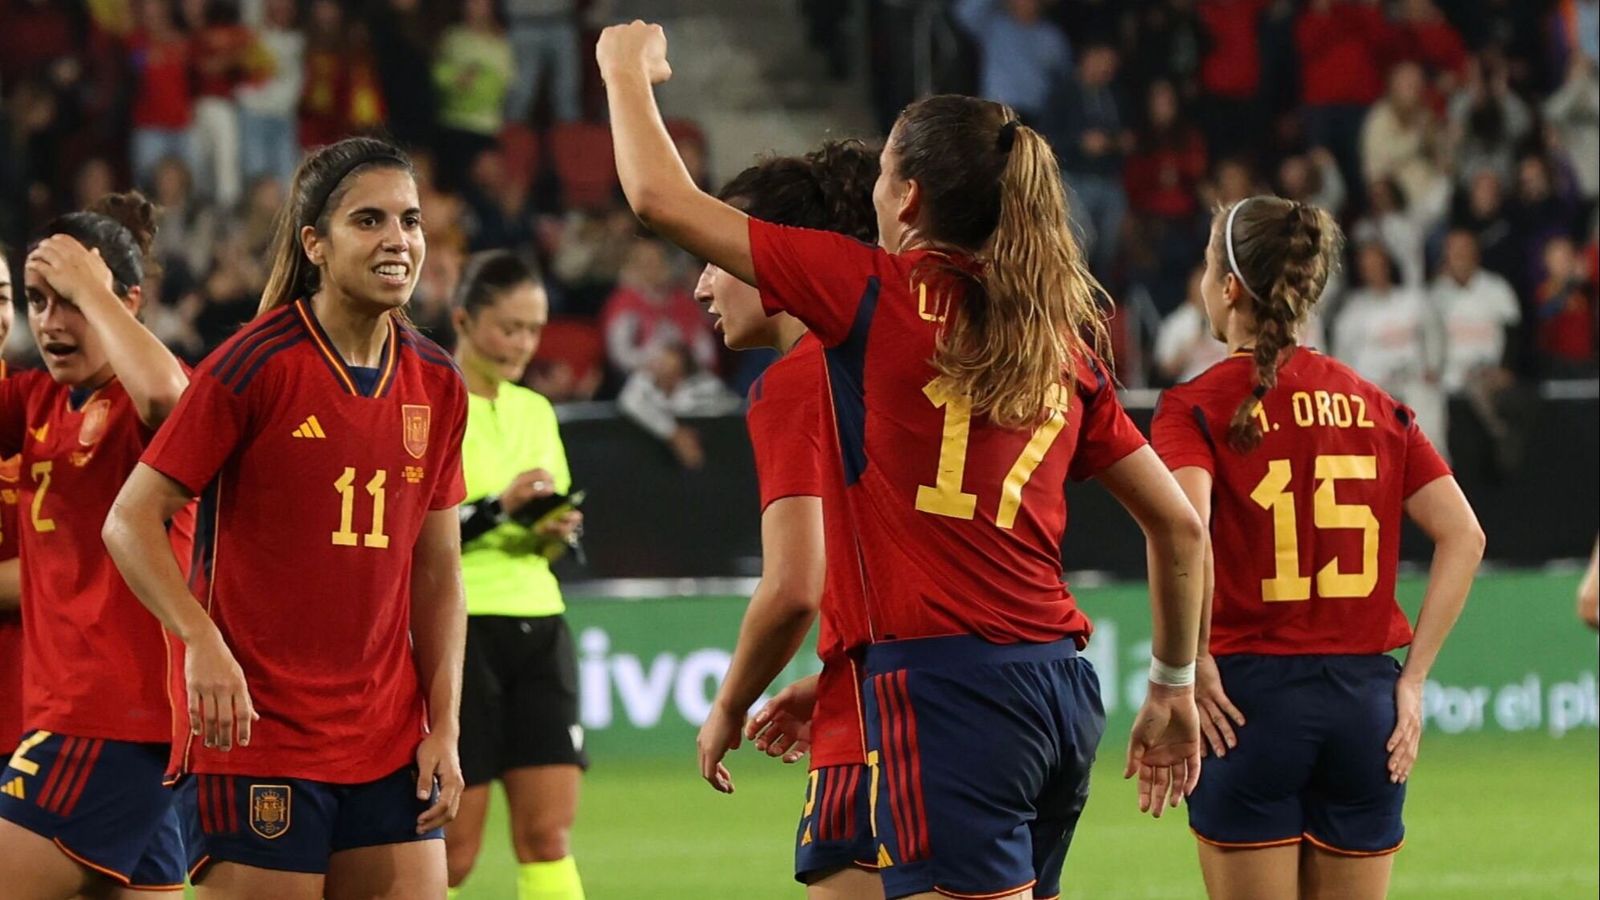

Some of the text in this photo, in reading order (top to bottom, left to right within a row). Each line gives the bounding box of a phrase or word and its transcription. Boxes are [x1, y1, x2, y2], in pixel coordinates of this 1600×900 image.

[1292, 390, 1375, 428] OROZ
[915, 374, 1069, 529] 17
[31, 461, 55, 532] 2
[332, 467, 389, 549] 11
[1250, 455, 1380, 602] 15
